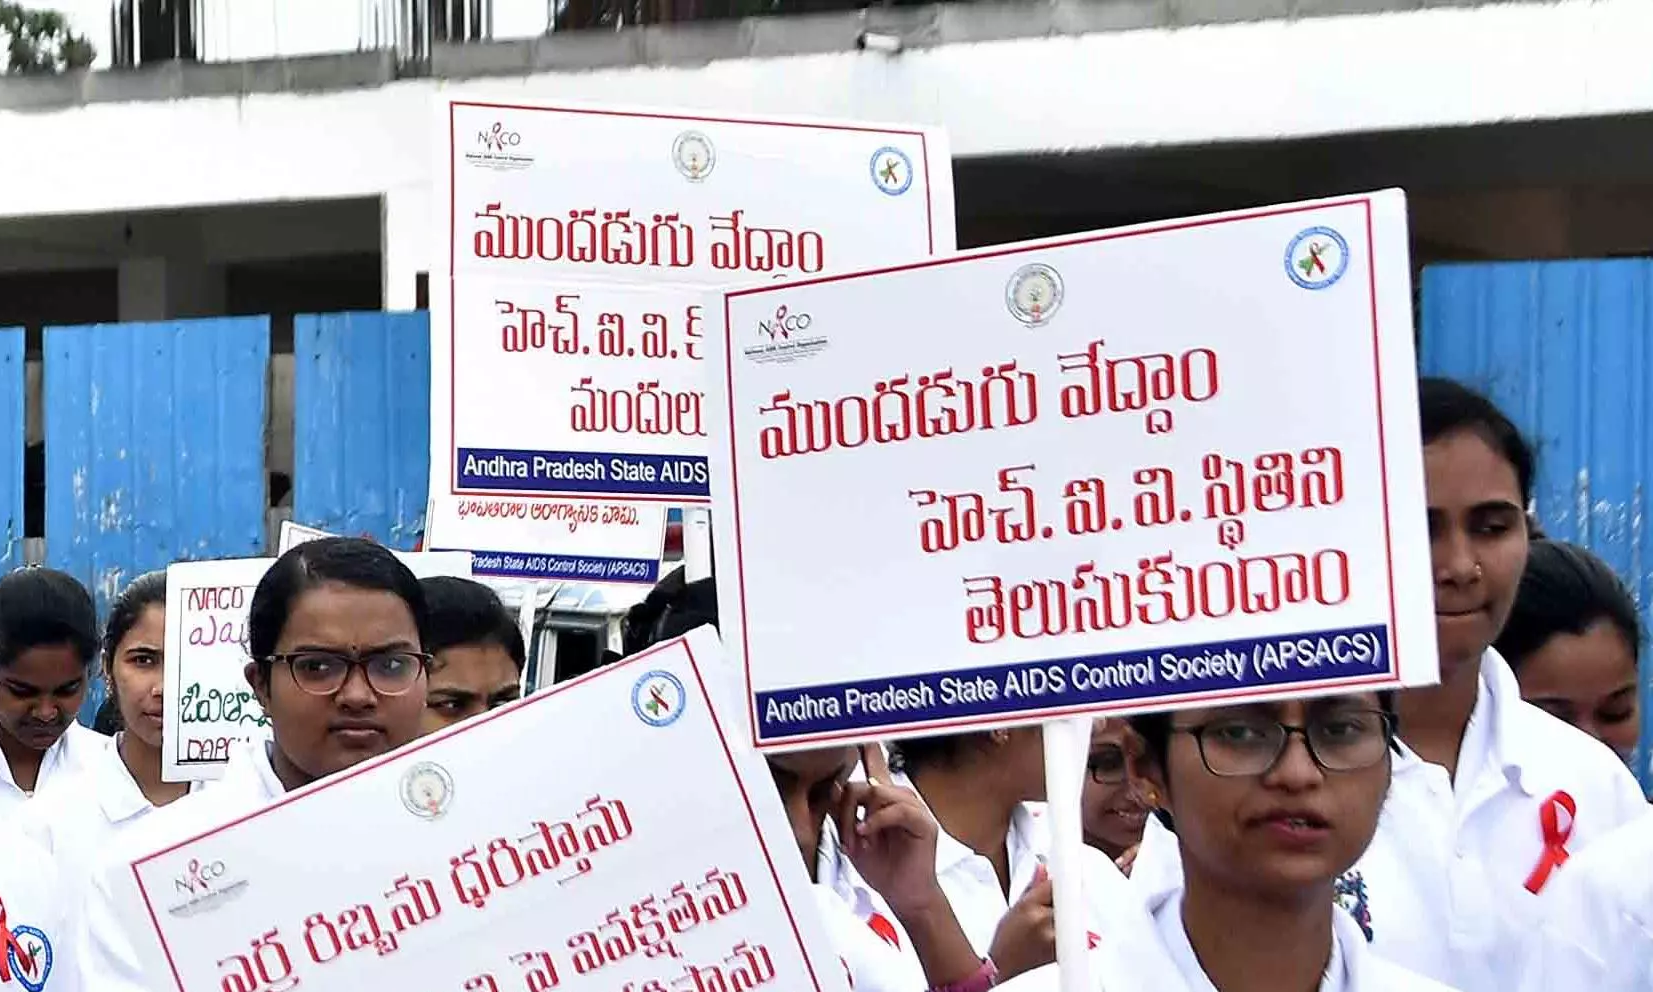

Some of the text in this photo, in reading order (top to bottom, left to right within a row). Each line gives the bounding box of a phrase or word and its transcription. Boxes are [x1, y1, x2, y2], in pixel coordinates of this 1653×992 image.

[475, 202, 693, 267] ముందడుగు
[760, 340, 1218, 459] ముందడుగు వేద్దాం
[464, 455, 707, 483] Andhra Pradesh State AIDS
[189, 586, 243, 611] NACO
[470, 553, 649, 578] Pradesh State AIDS Control Society (APSACS)
[963, 549, 1349, 644] తెలుసుకుందాం
[766, 632, 1380, 723] Andhra Pradesh State AIDS Control Society (APSACS)
[304, 875, 441, 963] రిబ్బను
[450, 795, 632, 908] ధరిస్తాను
[568, 868, 747, 974] వివక్షతను
